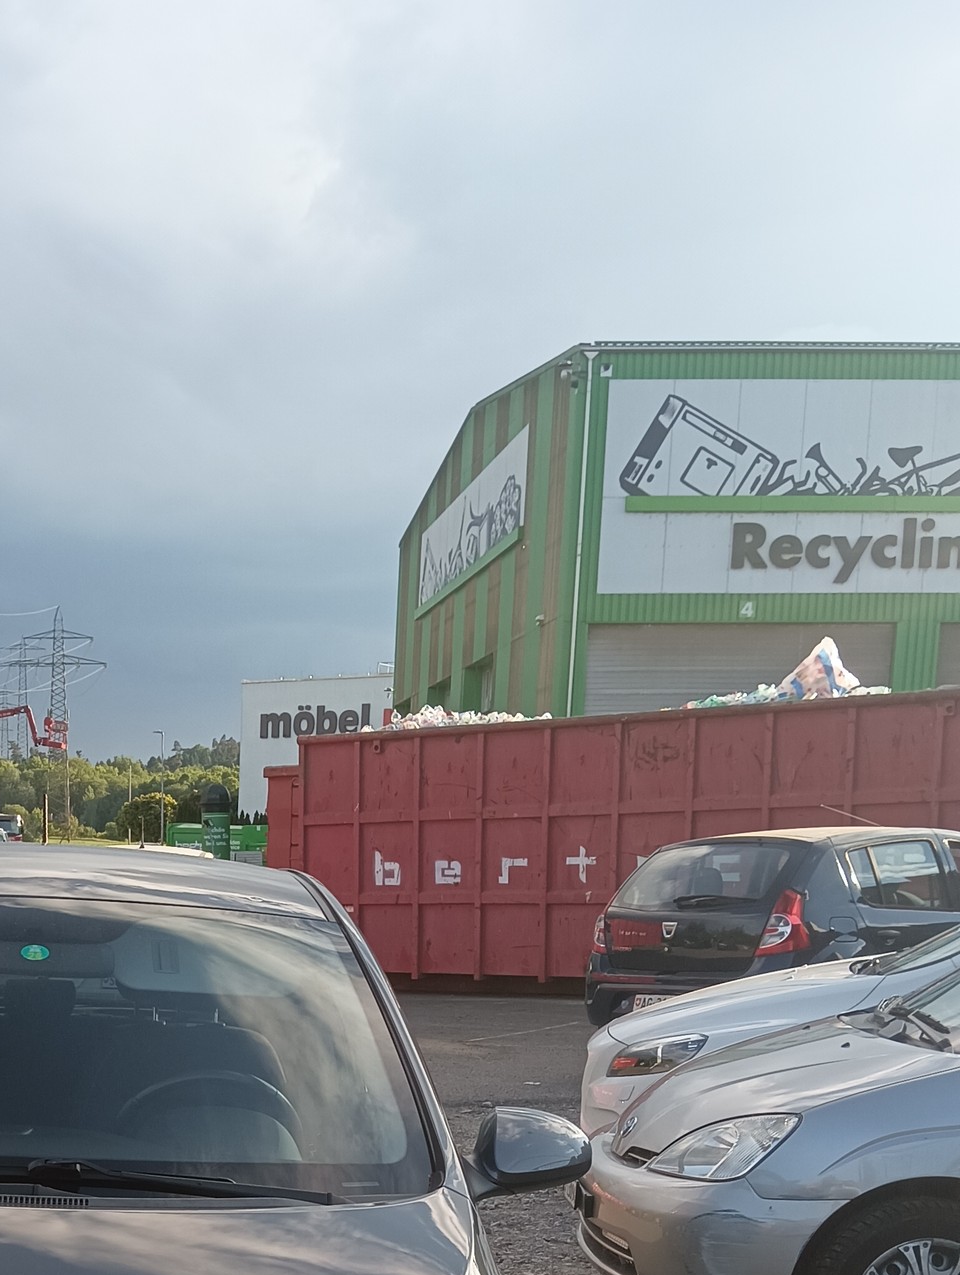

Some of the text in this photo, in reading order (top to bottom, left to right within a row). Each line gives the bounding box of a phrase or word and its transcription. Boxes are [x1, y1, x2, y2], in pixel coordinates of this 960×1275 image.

[731, 518, 960, 584] Recyclin
[741, 602, 754, 618] 4
[260, 703, 371, 739] möbel
